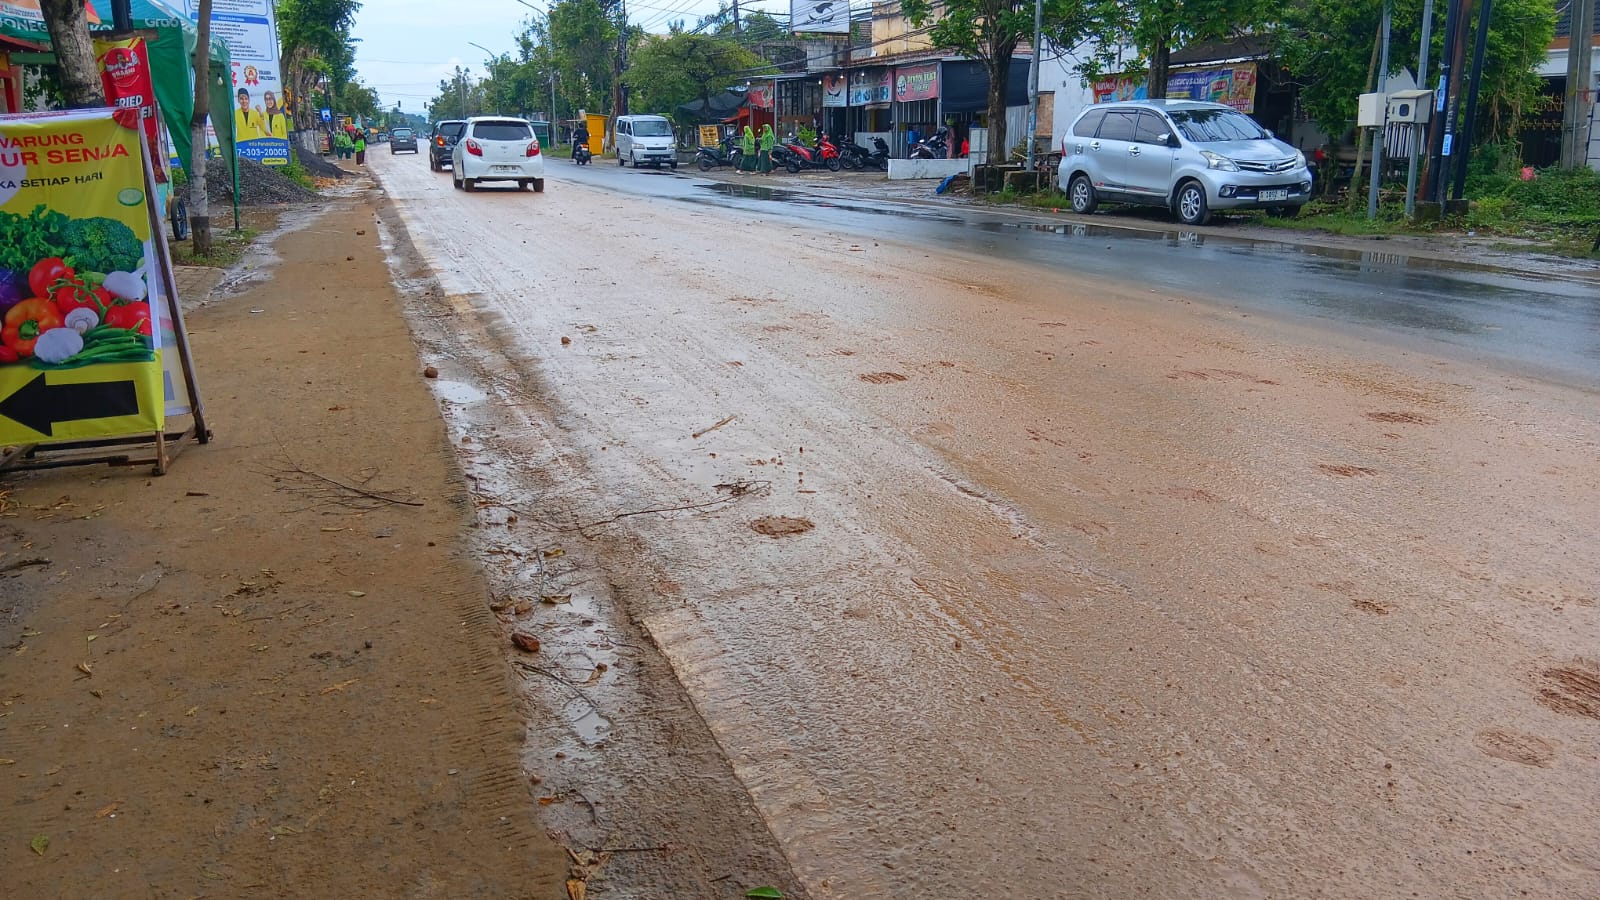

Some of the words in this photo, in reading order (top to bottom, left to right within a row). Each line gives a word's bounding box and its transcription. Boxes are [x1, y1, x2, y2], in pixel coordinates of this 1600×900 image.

[145, 17, 179, 28] Grab
[47, 143, 129, 165] SENJA
[20, 176, 70, 188] SETIAP
[74, 171, 103, 185] HARI
